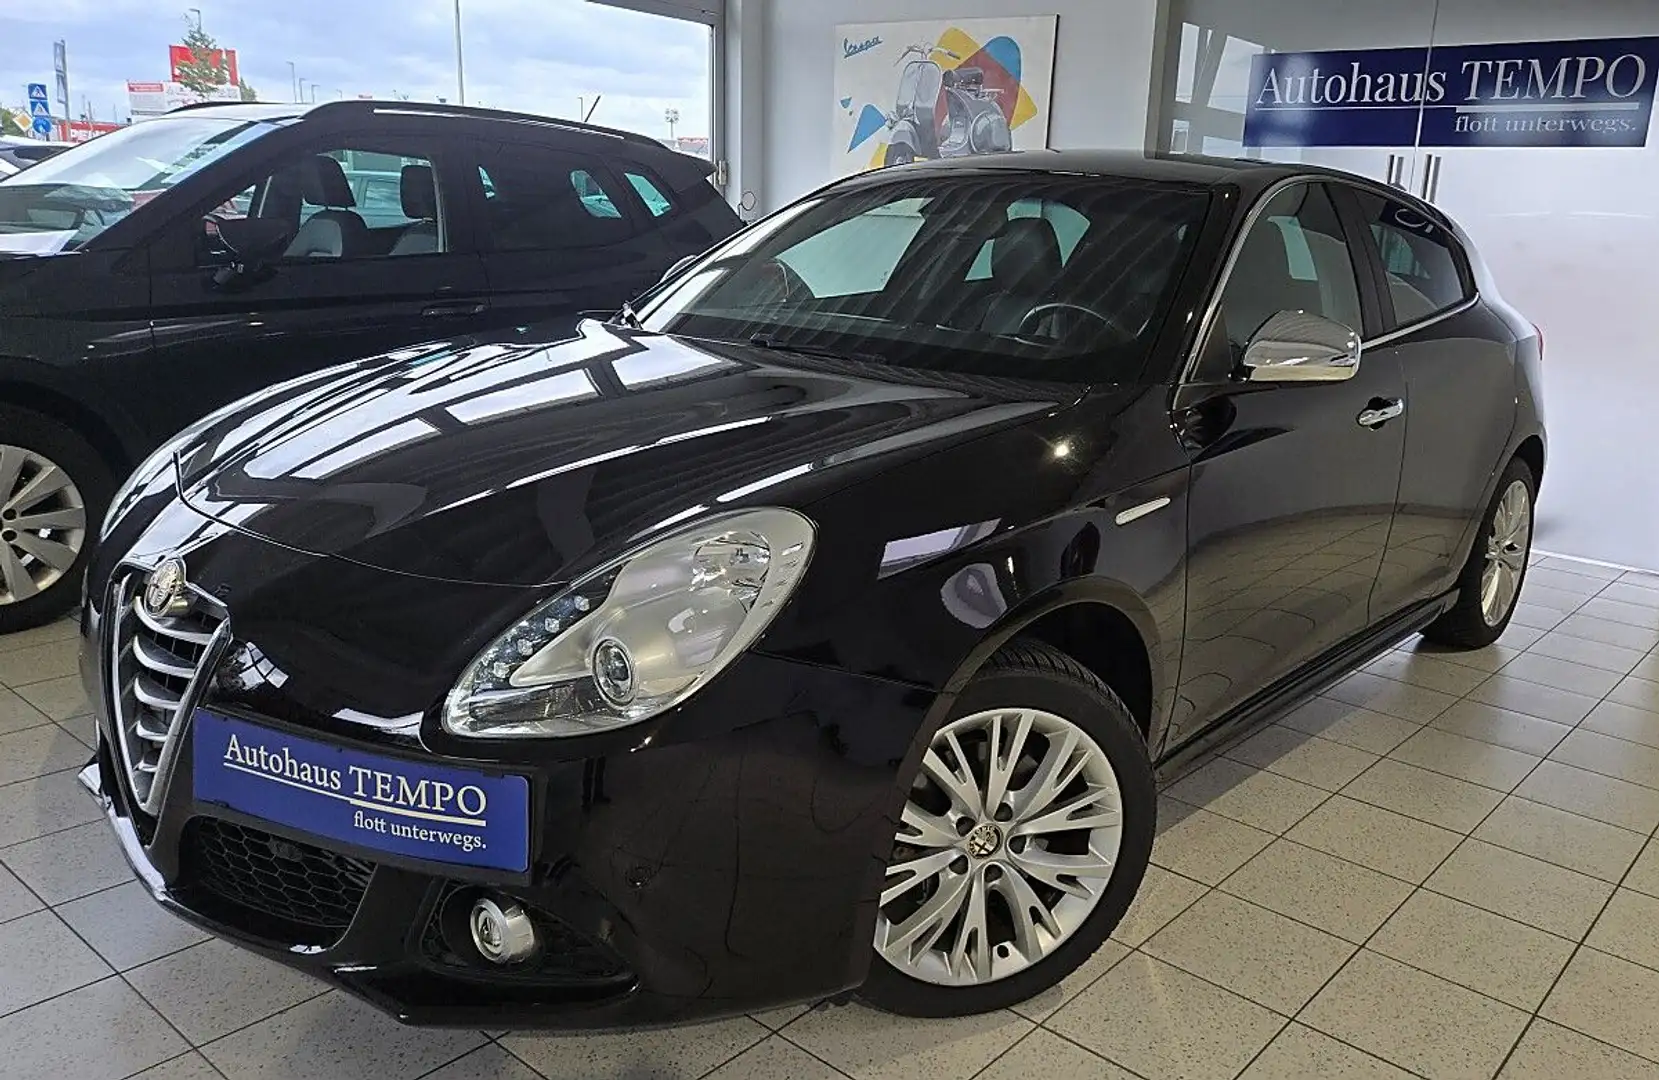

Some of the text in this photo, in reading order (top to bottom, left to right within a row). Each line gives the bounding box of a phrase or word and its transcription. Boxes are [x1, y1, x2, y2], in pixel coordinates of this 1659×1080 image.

[1256, 53, 1647, 104] Autohaus TEMPO
[1454, 115, 1636, 134] flott unterwegs.
[223, 734, 487, 817] Autohaus TEMPO
[353, 811, 487, 852] flott unterwegs.
